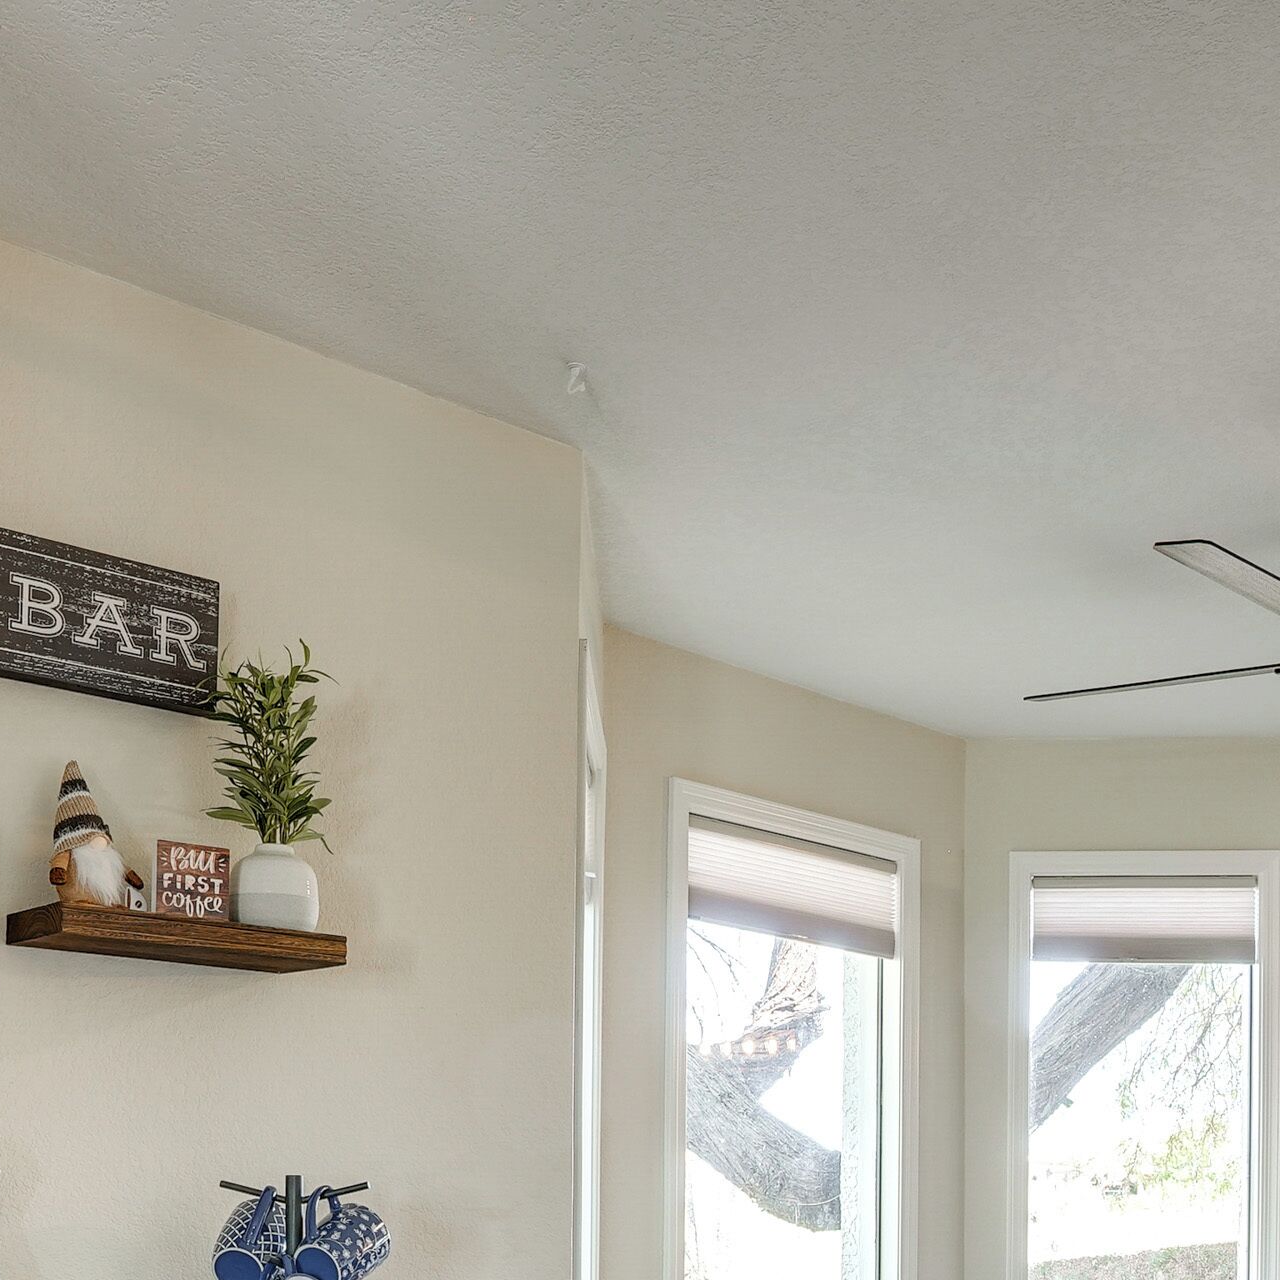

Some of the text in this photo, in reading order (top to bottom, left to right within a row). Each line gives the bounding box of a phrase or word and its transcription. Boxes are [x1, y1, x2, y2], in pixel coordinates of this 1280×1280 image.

[8, 572, 207, 673] BAR
[162, 873, 223, 894] FIRST
[162, 891, 223, 918] coffee
